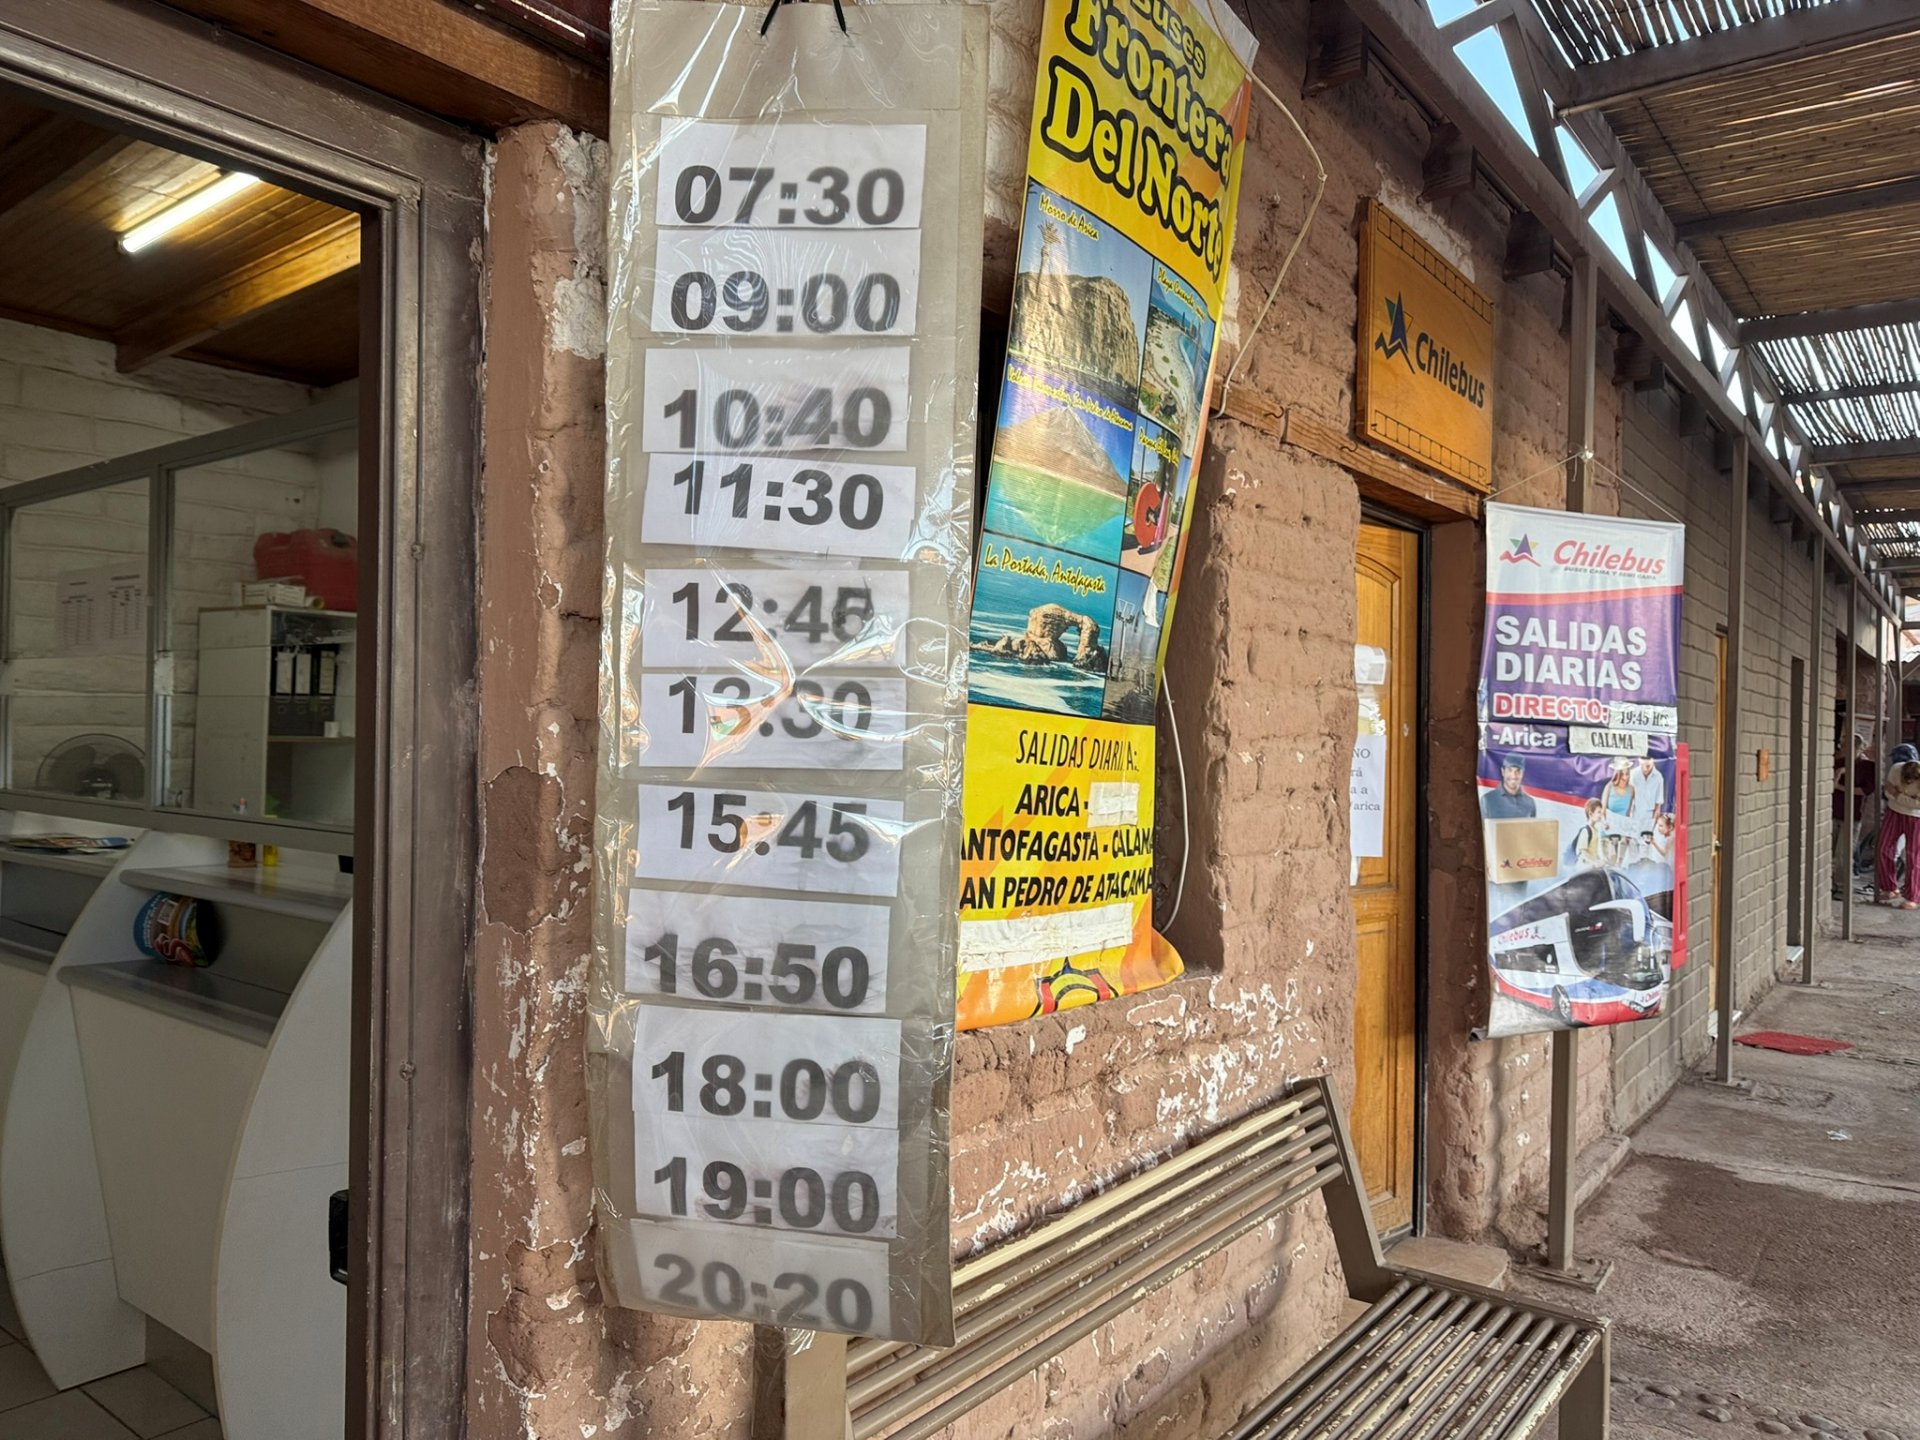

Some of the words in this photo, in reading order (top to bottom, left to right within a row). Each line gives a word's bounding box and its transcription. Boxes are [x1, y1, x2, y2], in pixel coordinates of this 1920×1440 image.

[674, 165, 905, 226] 07:30
[1040, 55, 1138, 198] Del
[1136, 126, 1223, 284] Norte
[670, 271, 901, 332] 09:00
[1415, 332, 1485, 409] Chilebus
[663, 388, 893, 448] 10:40
[673, 463, 885, 531] 11:30
[984, 543, 999, 567] La
[1000, 547, 1049, 582] Portada,
[1050, 560, 1105, 597] Antofagasta
[1553, 540, 1665, 575] Chilebus
[670, 581, 874, 644] 12:45
[1495, 615, 1647, 657] SALIDAS
[1496, 652, 1642, 691] DIARIAS
[1492, 727, 1557, 747] -Arica
[1591, 732, 1634, 750] CALAMA
[1494, 693, 1609, 722] DIRECTO:
[1620, 710, 1649, 726] 19:45
[1016, 729, 1087, 768] SALIDAS
[667, 791, 870, 862] 15:45
[1014, 783, 1080, 817] ARICA
[1002, 875, 1067, 908] PEDRO
[1068, 874, 1094, 904] DE
[1093, 867, 1153, 902] ATACAMA
[644, 934, 870, 1008] 16:50
[651, 1051, 881, 1123] 18:00
[654, 1157, 880, 1233] 19:00
[654, 1253, 875, 1333] 20:20
